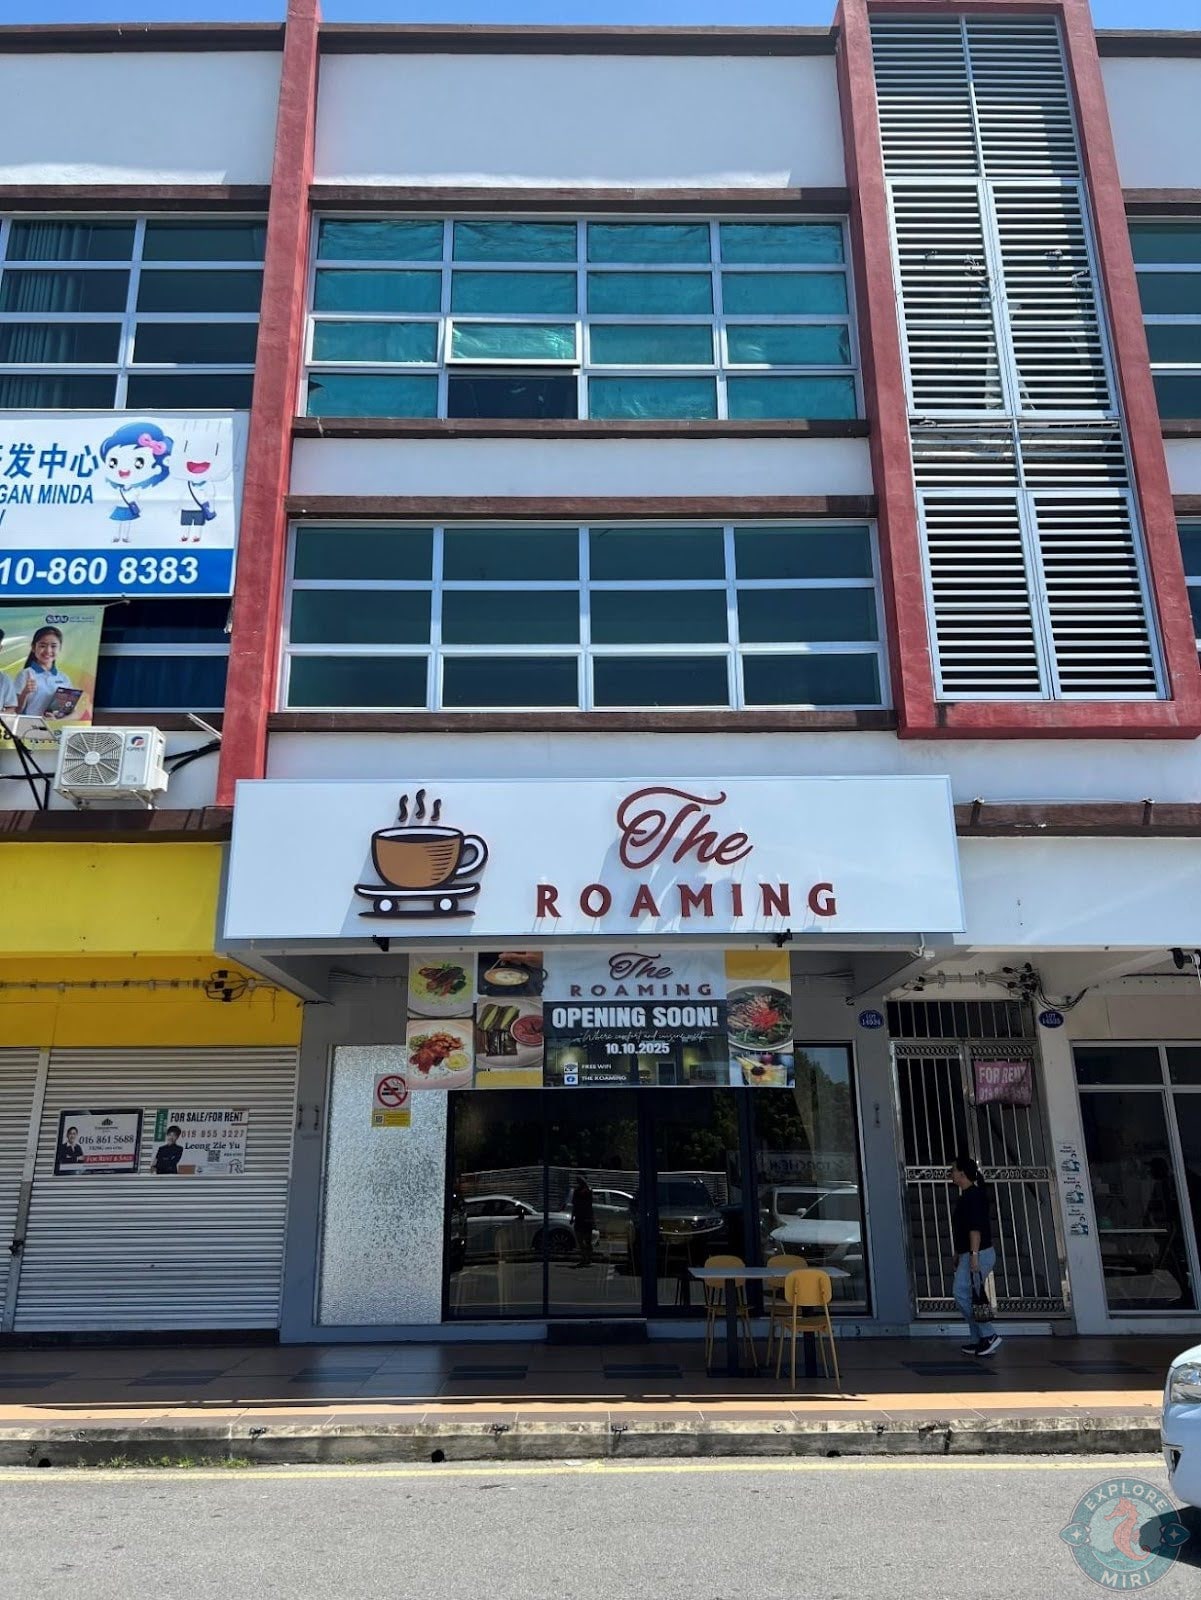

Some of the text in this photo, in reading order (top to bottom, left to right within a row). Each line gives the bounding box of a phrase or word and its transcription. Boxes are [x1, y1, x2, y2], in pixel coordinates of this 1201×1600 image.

[0, 443, 99, 479] 发中心
[38, 484, 93, 504] MINDA
[0, 557, 199, 585] 10-860 8383
[616, 787, 753, 869] The
[536, 883, 837, 918] ROAMING
[608, 952, 673, 981] The
[569, 984, 711, 997] ROAMING
[552, 1007, 718, 1029] OPENING SOON!
[605, 1043, 671, 1055] 10.10.2025
[979, 1066, 1026, 1084] FOR RENT
[171, 1112, 243, 1122] FOR SALE/FOR RENT
[79, 1135, 94, 1145] 016
[185, 1142, 240, 1152] Leong Zie Yu
